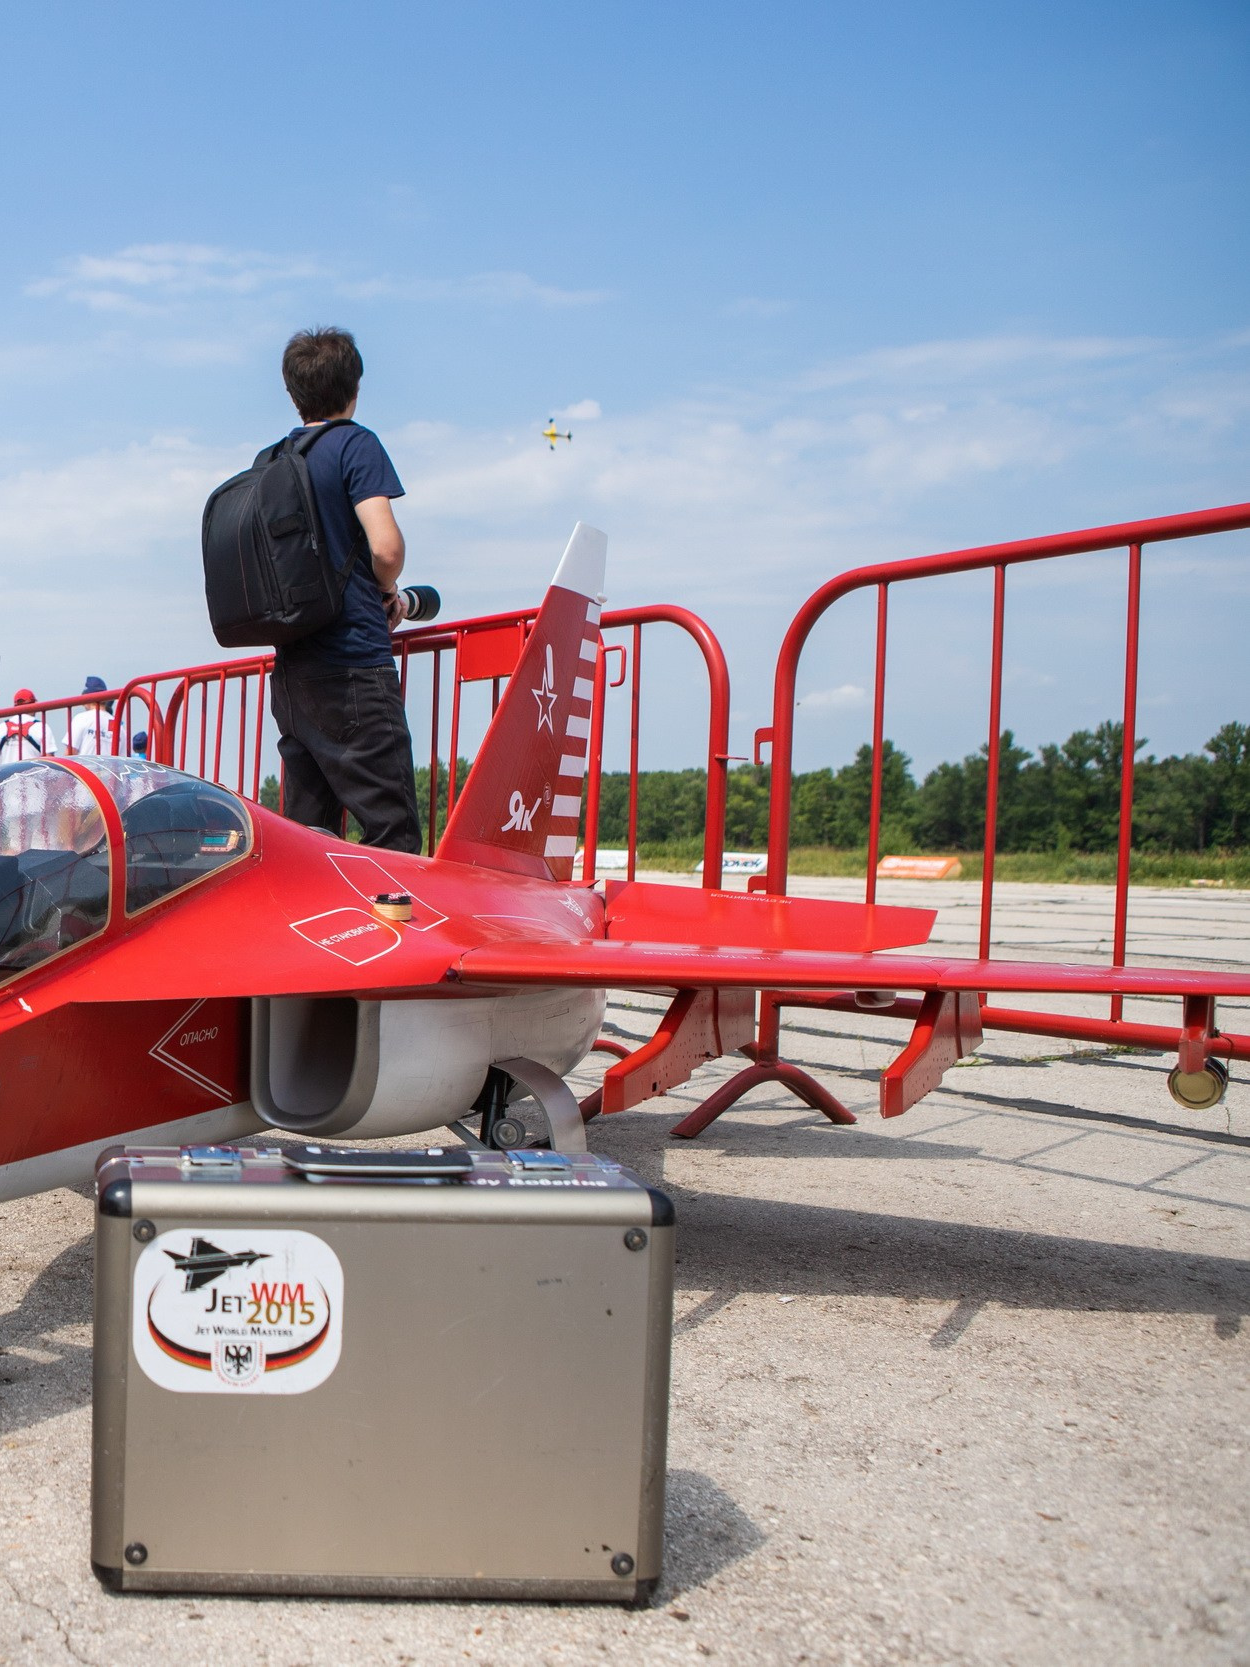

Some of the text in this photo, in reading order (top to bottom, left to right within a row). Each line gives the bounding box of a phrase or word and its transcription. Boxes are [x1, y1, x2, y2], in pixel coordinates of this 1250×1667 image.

[179, 1026, 219, 1047] ОПАСНО
[251, 1282, 305, 1307] WM
[246, 1301, 316, 1326] 2015
